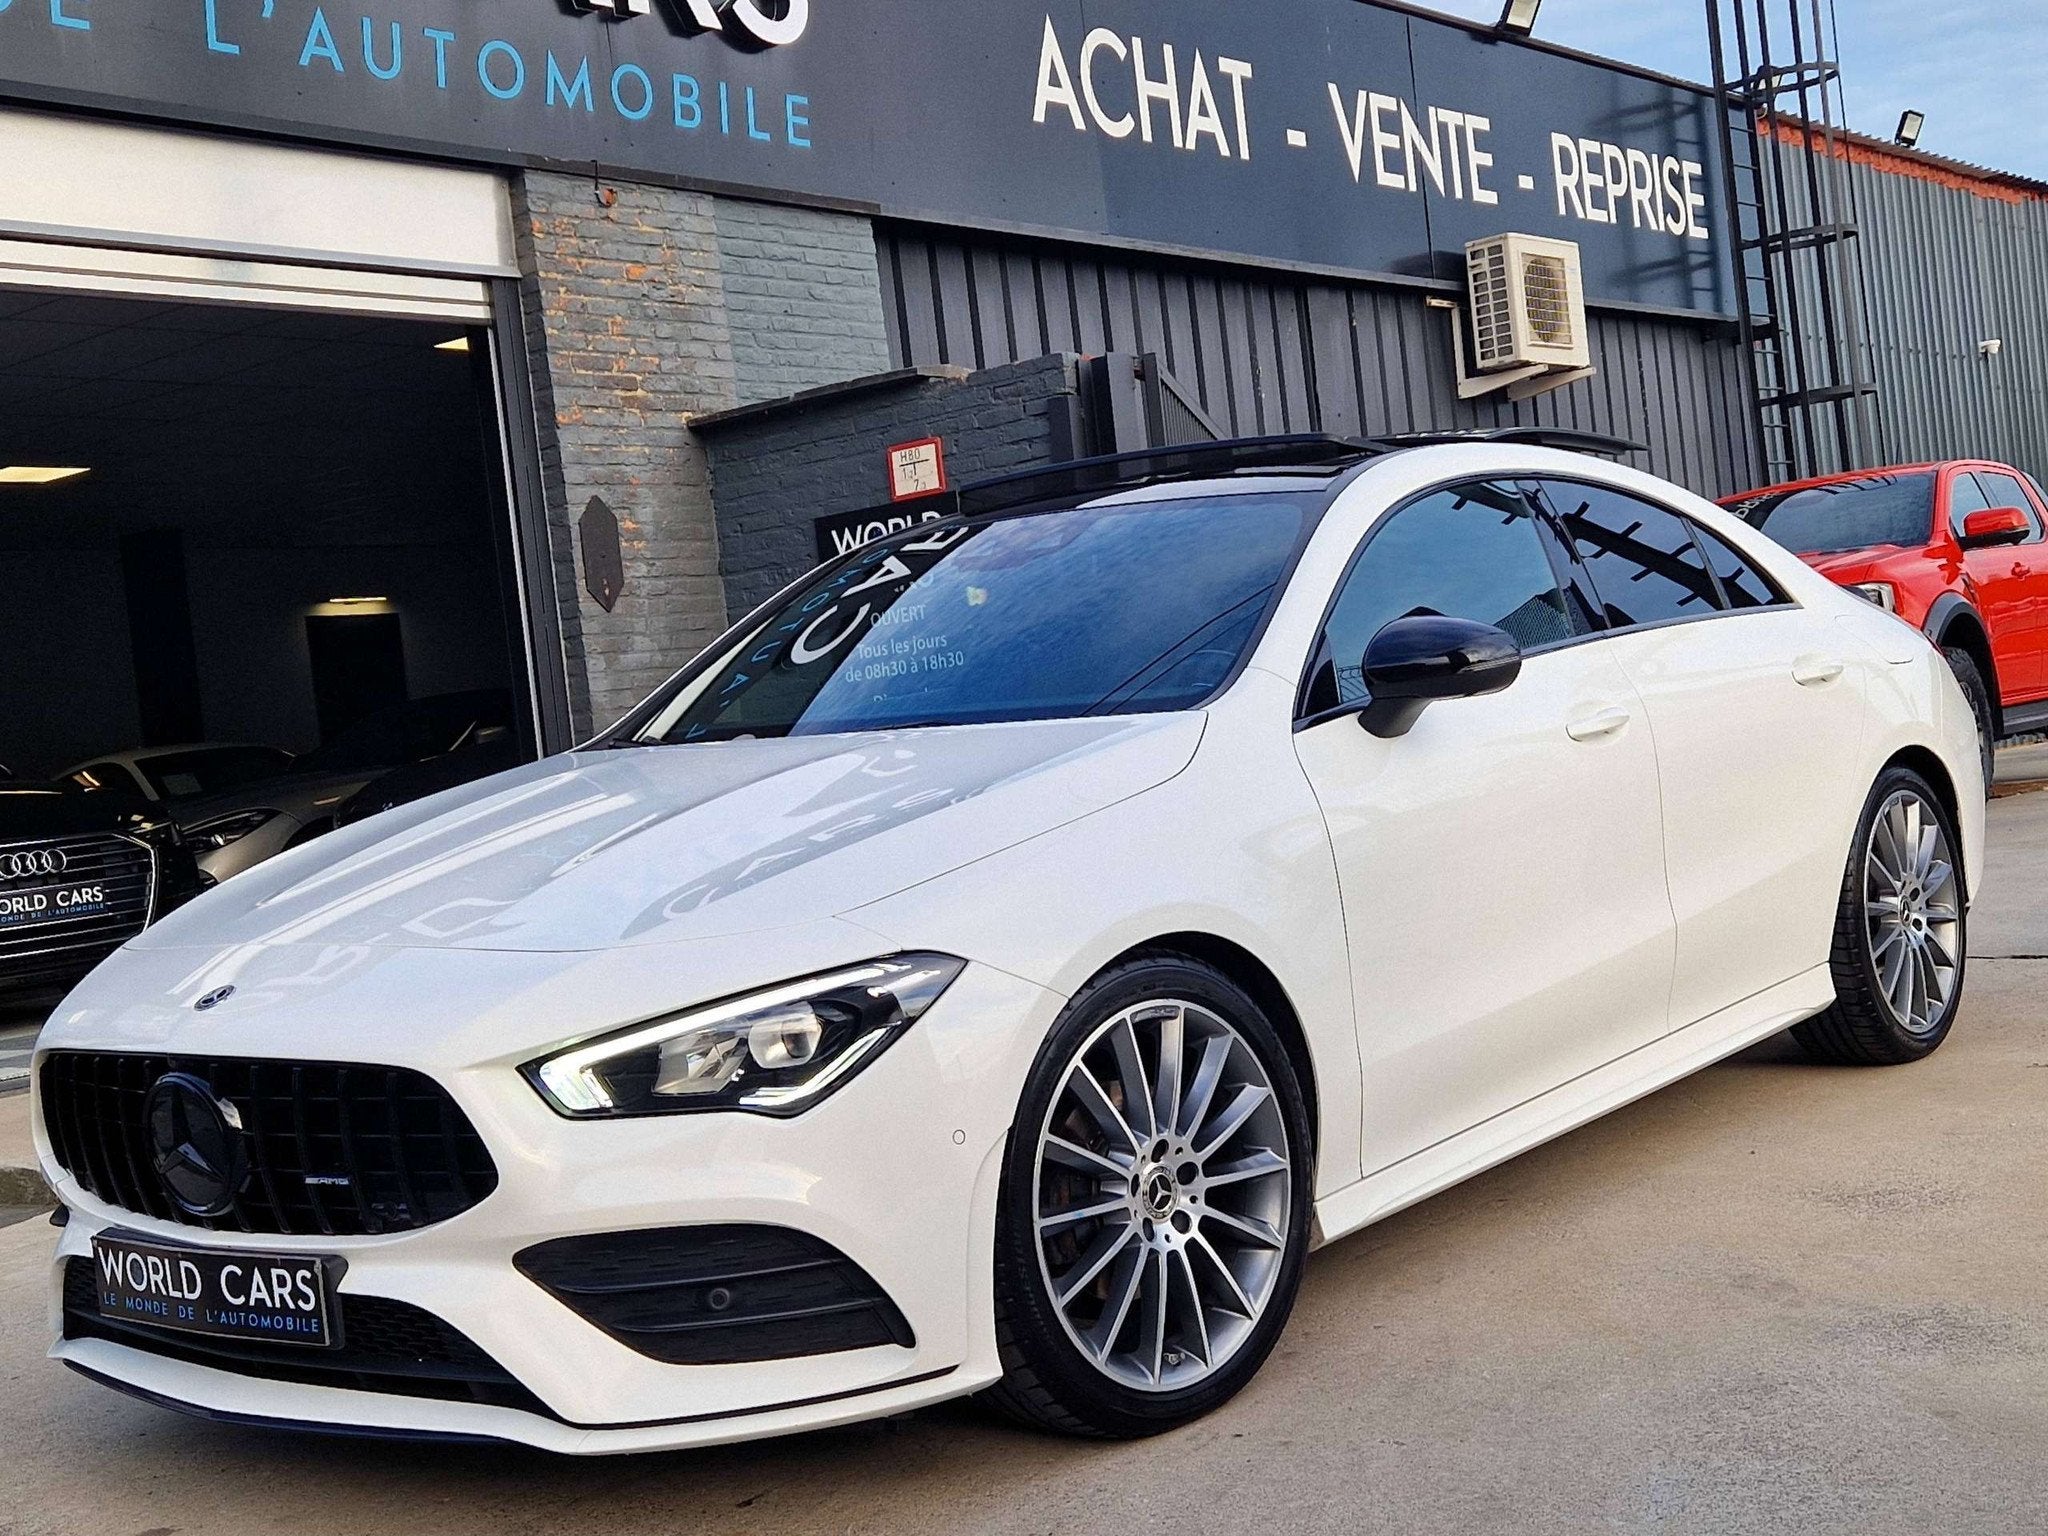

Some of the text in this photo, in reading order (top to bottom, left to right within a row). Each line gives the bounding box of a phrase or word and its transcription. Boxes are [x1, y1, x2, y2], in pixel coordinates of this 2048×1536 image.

[205, 0, 811, 147] L'AUTOMOBILE
[1032, 13, 1252, 160] ACHAT
[1327, 82, 1499, 205] VENTE
[1550, 131, 1709, 239] REPRISE
[871, 604, 926, 627] OUVERT
[859, 634, 948, 660] Tous les jours
[845, 651, 965, 683] de 08h30 à 18h30
[0, 886, 104, 915] ORLD CARS
[98, 1247, 316, 1312] WORLD CARS
[104, 1292, 320, 1333] LE MONDE DE L'AUTOMOBILE
